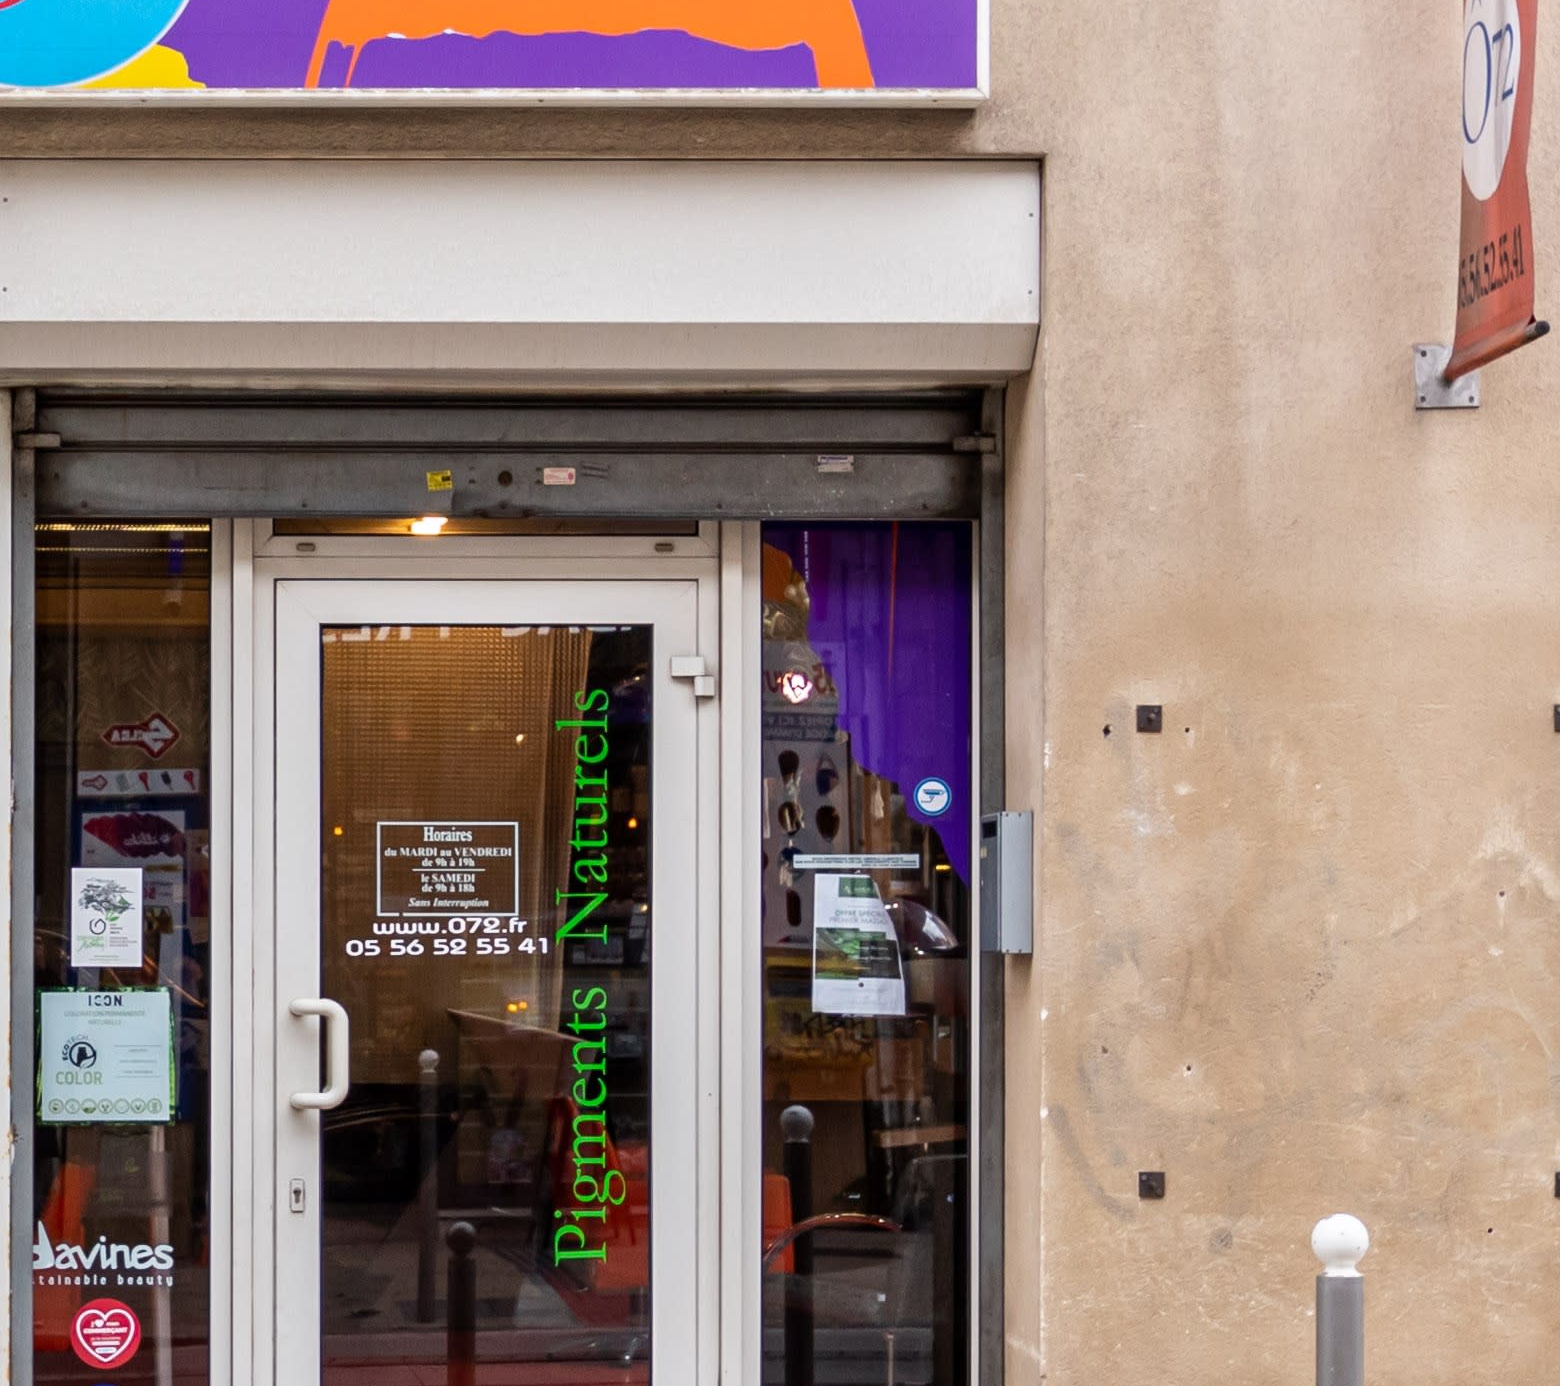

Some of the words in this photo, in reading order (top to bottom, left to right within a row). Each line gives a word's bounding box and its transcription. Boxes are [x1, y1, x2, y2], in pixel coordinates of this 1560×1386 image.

[554, 689, 610, 945] Naturels
[423, 826, 473, 842] Horaires
[384, 847, 398, 857] du
[399, 847, 438, 857] MARDI
[439, 849, 452, 857] au
[454, 847, 512, 857] VENDREDI
[421, 858, 433, 867] de
[435, 858, 447, 867] 9h
[449, 857, 456, 867] à
[458, 858, 475, 867] 19h
[421, 873, 430, 883] le
[431, 873, 476, 883] SAMEDI
[421, 883, 433, 893] de
[435, 883, 447, 893] 9h
[449, 882, 456, 893] à
[458, 883, 475, 893] 18h
[407, 897, 431, 908] Sans
[432, 897, 489, 910] Interruption
[345, 939, 381, 956] 05
[389, 939, 425, 956] 56
[432, 938, 467, 955] 52
[476, 938, 510, 955] 55
[517, 937, 548, 954] 41
[87, 994, 123, 1007] ICON
[55, 1070, 103, 1086] COLOR
[554, 987, 626, 1267] Pigments
[32, 1220, 174, 1270] davines
[33, 1274, 107, 1287] tainable
[117, 1274, 174, 1288] beauty
